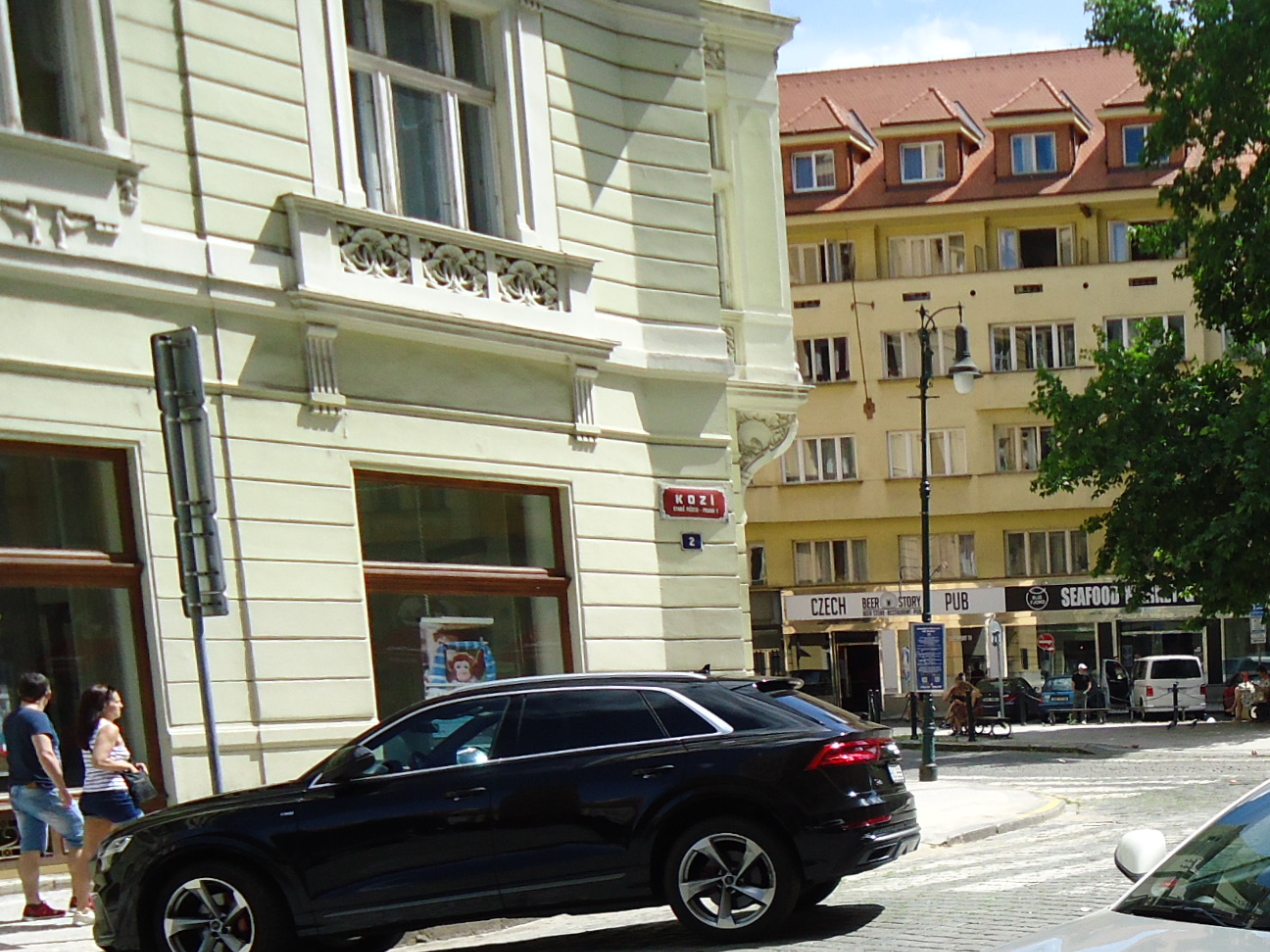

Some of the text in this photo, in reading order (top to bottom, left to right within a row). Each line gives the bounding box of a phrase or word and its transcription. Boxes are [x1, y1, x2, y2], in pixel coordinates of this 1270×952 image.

[688, 536, 695, 547] 2
[811, 592, 969, 616] CZECH BEER STORY PUB
[1061, 585, 1120, 608] SEAFOOD
